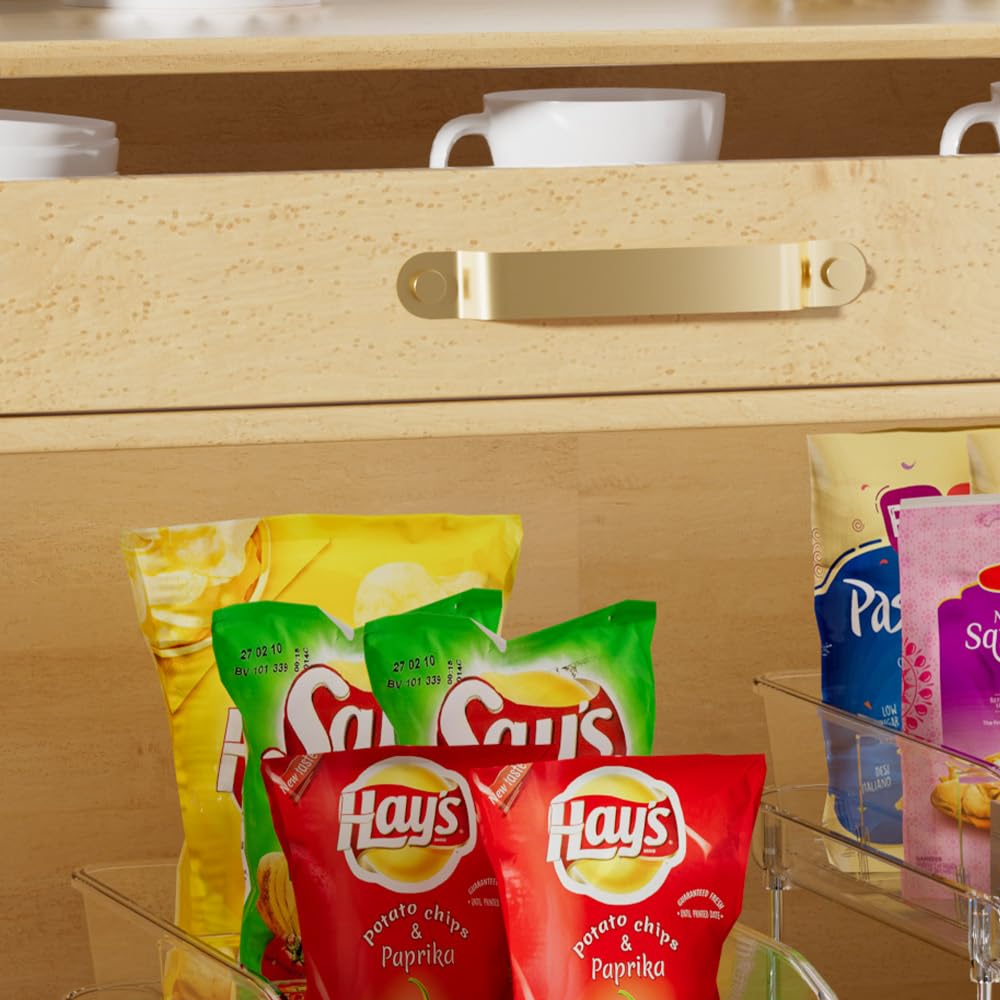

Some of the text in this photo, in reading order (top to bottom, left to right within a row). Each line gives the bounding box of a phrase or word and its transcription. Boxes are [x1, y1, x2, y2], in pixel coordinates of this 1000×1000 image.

[241, 643, 282, 660] 27 02 10
[393, 655, 435, 672] 27 02 10
[387, 679, 400, 689] BV
[406, 678, 423, 687] 101
[337, 790, 462, 851] Hay's
[546, 801, 671, 862] Hay's
[411, 923, 422, 939] &
[424, 904, 469, 939] chips
[634, 916, 679, 951] chips
[382, 941, 455, 973] Paprika
[621, 934, 632, 952] &
[592, 953, 665, 986] Paprika
